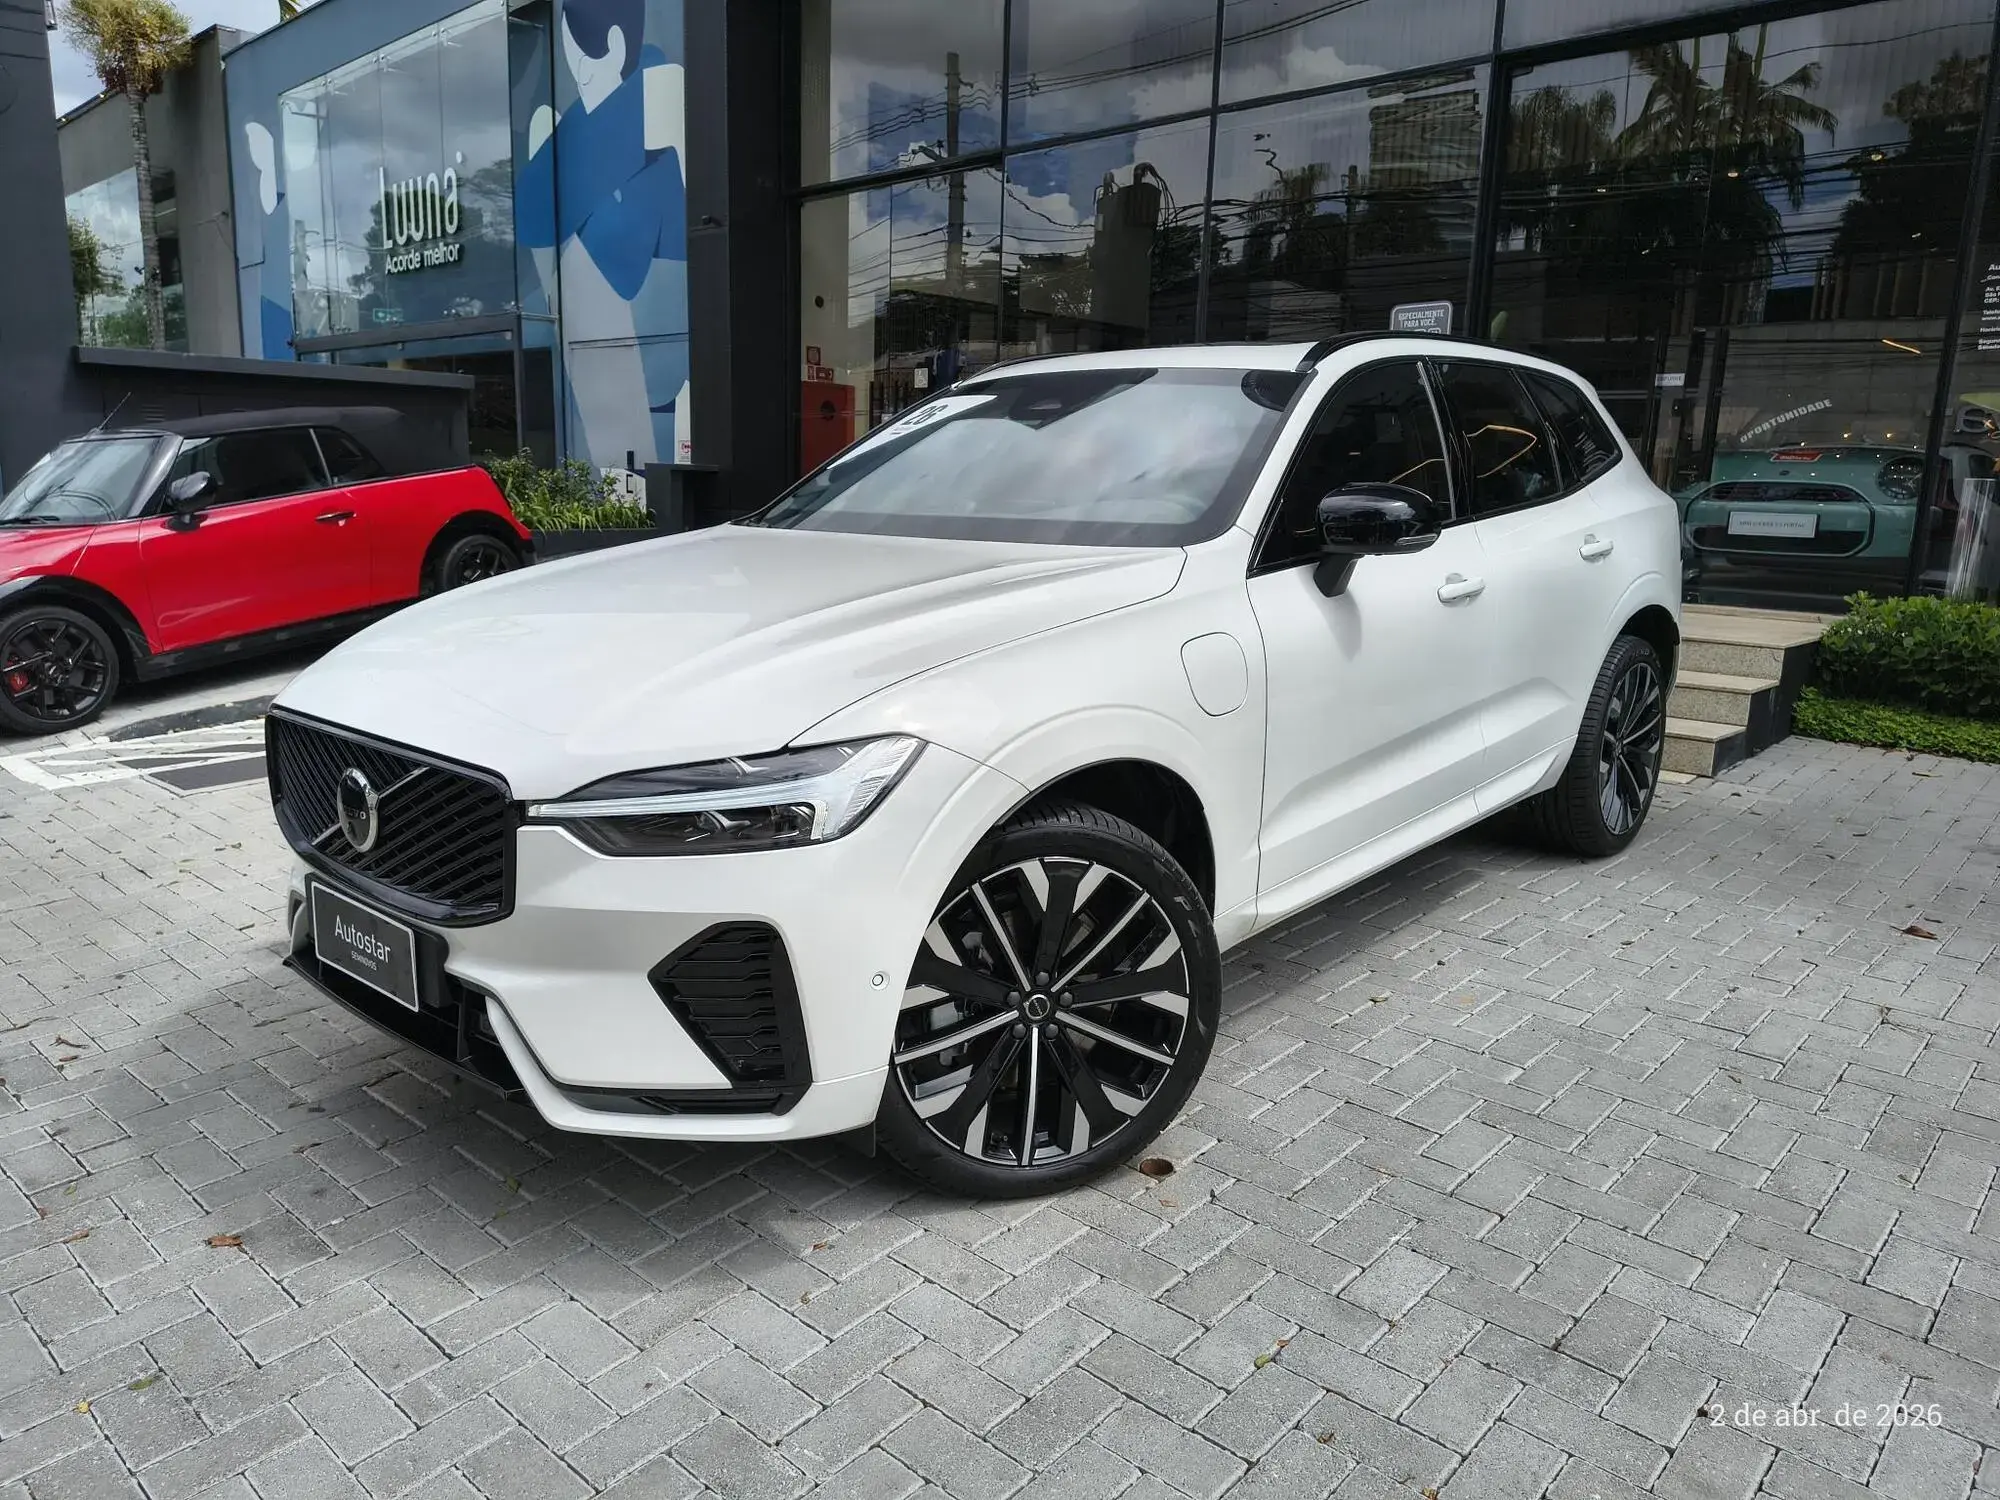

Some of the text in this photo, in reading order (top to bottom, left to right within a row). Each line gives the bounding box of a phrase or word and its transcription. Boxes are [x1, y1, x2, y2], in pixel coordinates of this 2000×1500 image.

[379, 166, 459, 249] Luuna
[385, 242, 460, 274] Acorde melhor
[1399, 309, 1445, 320] ESPECIALMENTE
[1403, 319, 1419, 329] PARA
[1740, 399, 1832, 443] OPORTUNIDADE
[334, 915, 391, 963] Autostar
